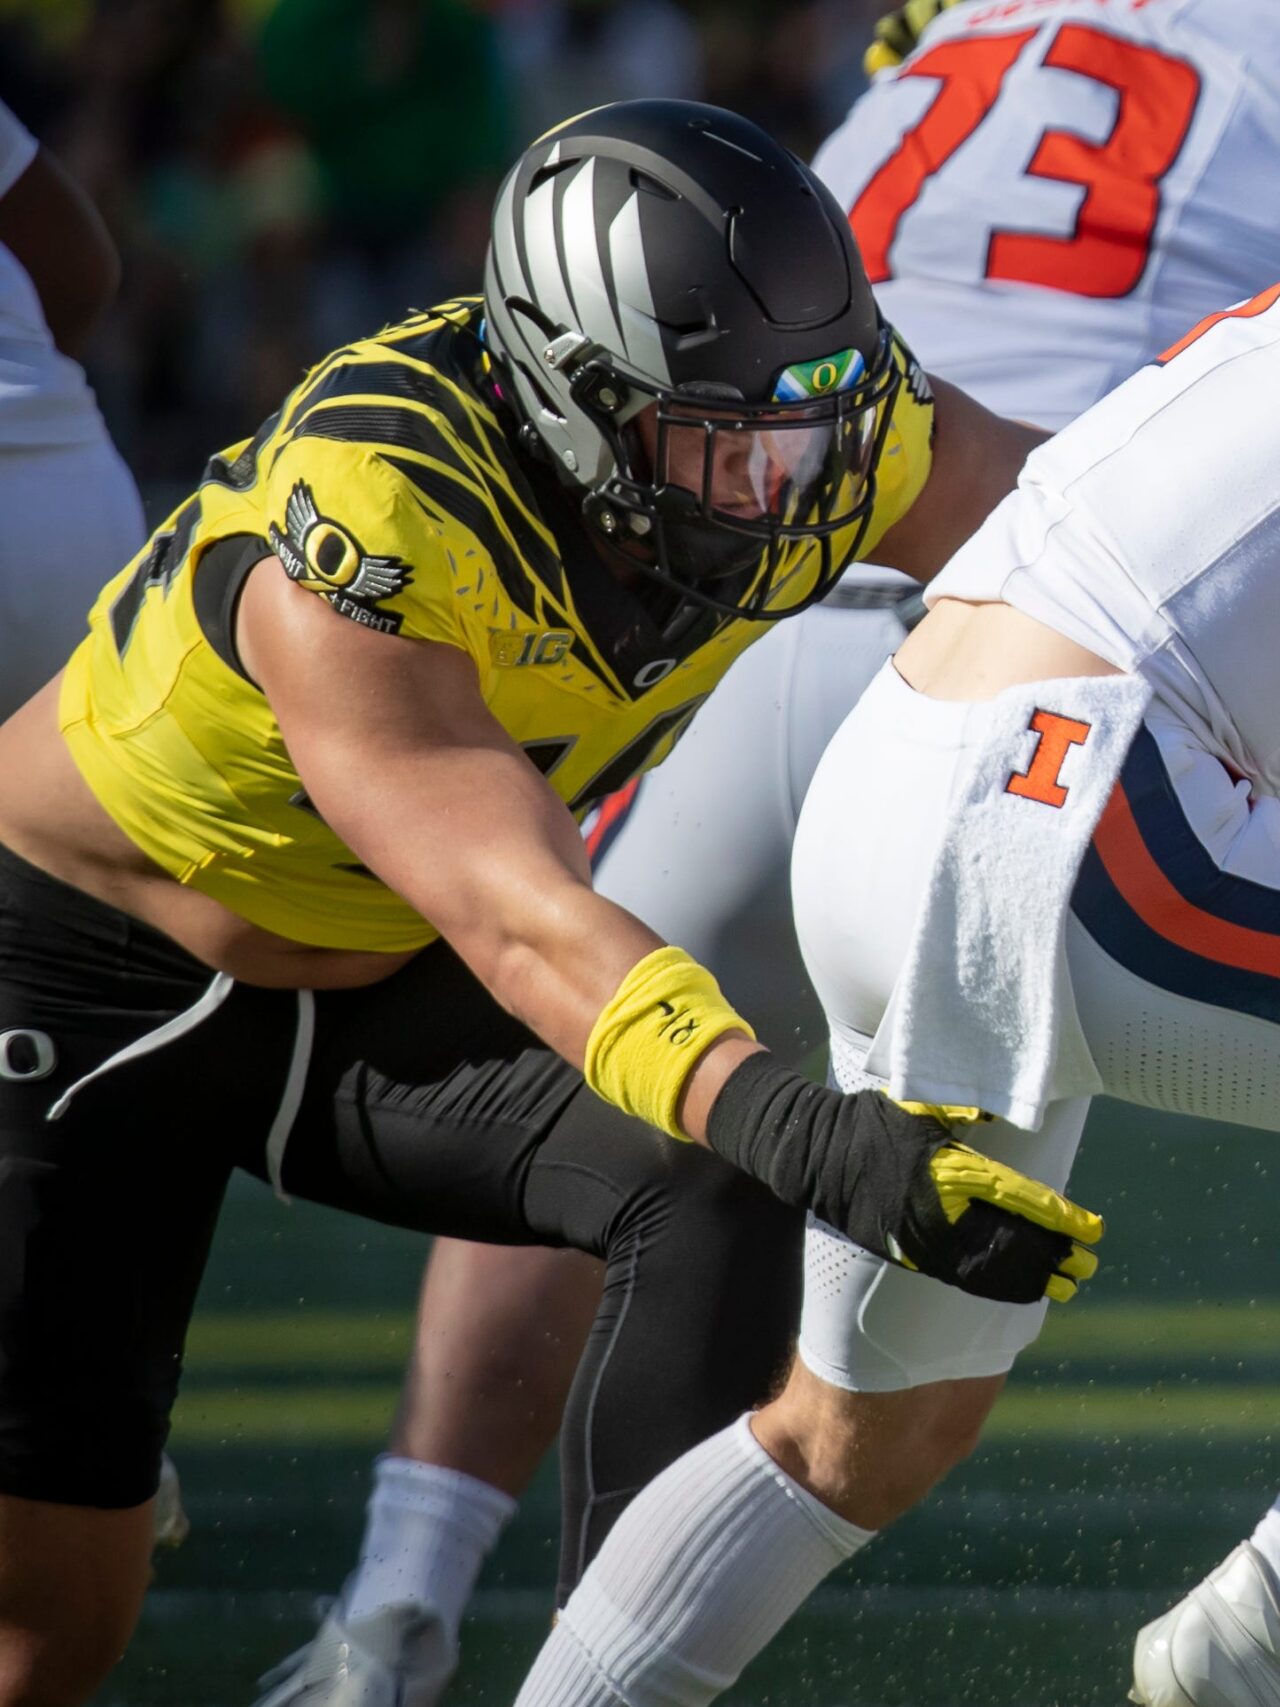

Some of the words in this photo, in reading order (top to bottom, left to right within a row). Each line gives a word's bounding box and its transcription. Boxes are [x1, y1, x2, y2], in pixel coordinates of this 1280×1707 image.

[850, 22, 1202, 298] 73
[812, 362, 837, 393] O
[305, 522, 359, 586] O
[340, 598, 397, 633] FIGHT
[632, 658, 677, 688] O
[1004, 707, 1093, 810] I
[0, 1028, 55, 1080] O
